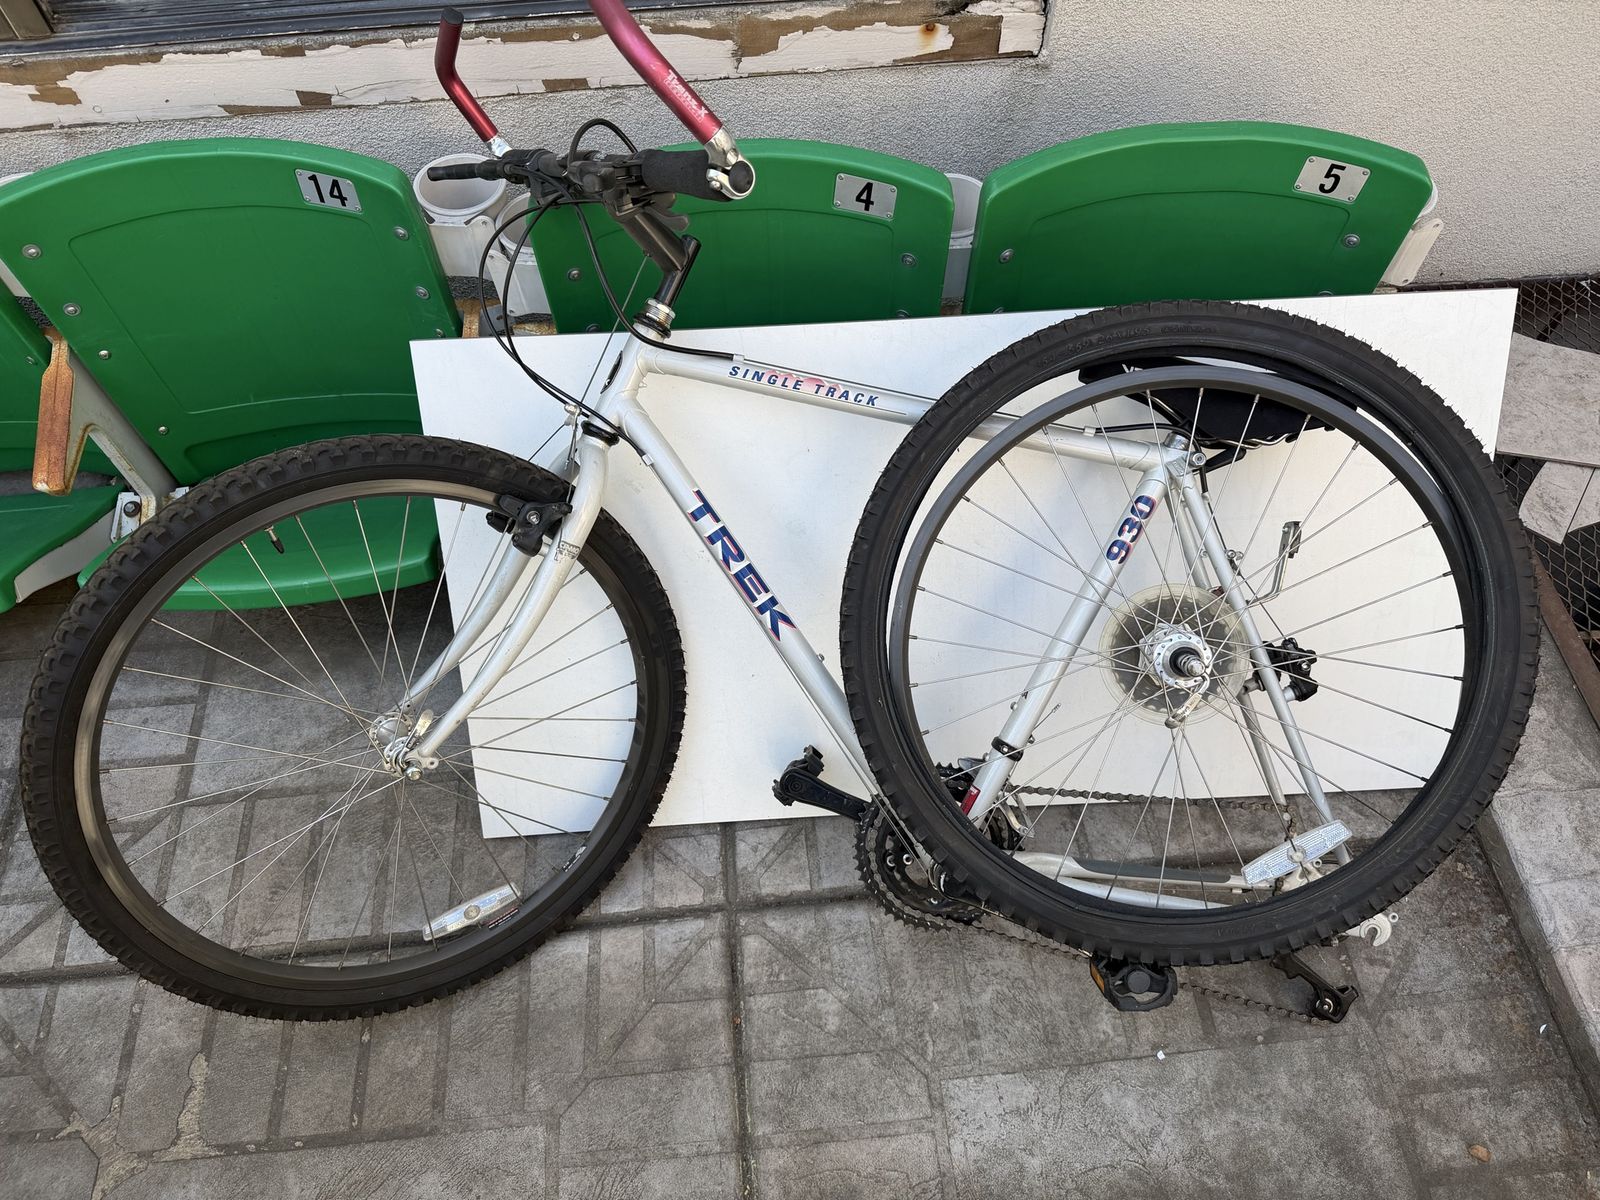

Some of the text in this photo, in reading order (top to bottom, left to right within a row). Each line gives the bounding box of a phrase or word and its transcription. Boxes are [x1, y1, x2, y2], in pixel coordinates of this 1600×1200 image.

[307, 174, 348, 207] 14
[855, 181, 875, 212] 4
[1318, 163, 1346, 194] 5
[729, 365, 880, 407] SINGLE TRACK
[1106, 494, 1157, 565] 930
[687, 488, 797, 642] TREK
